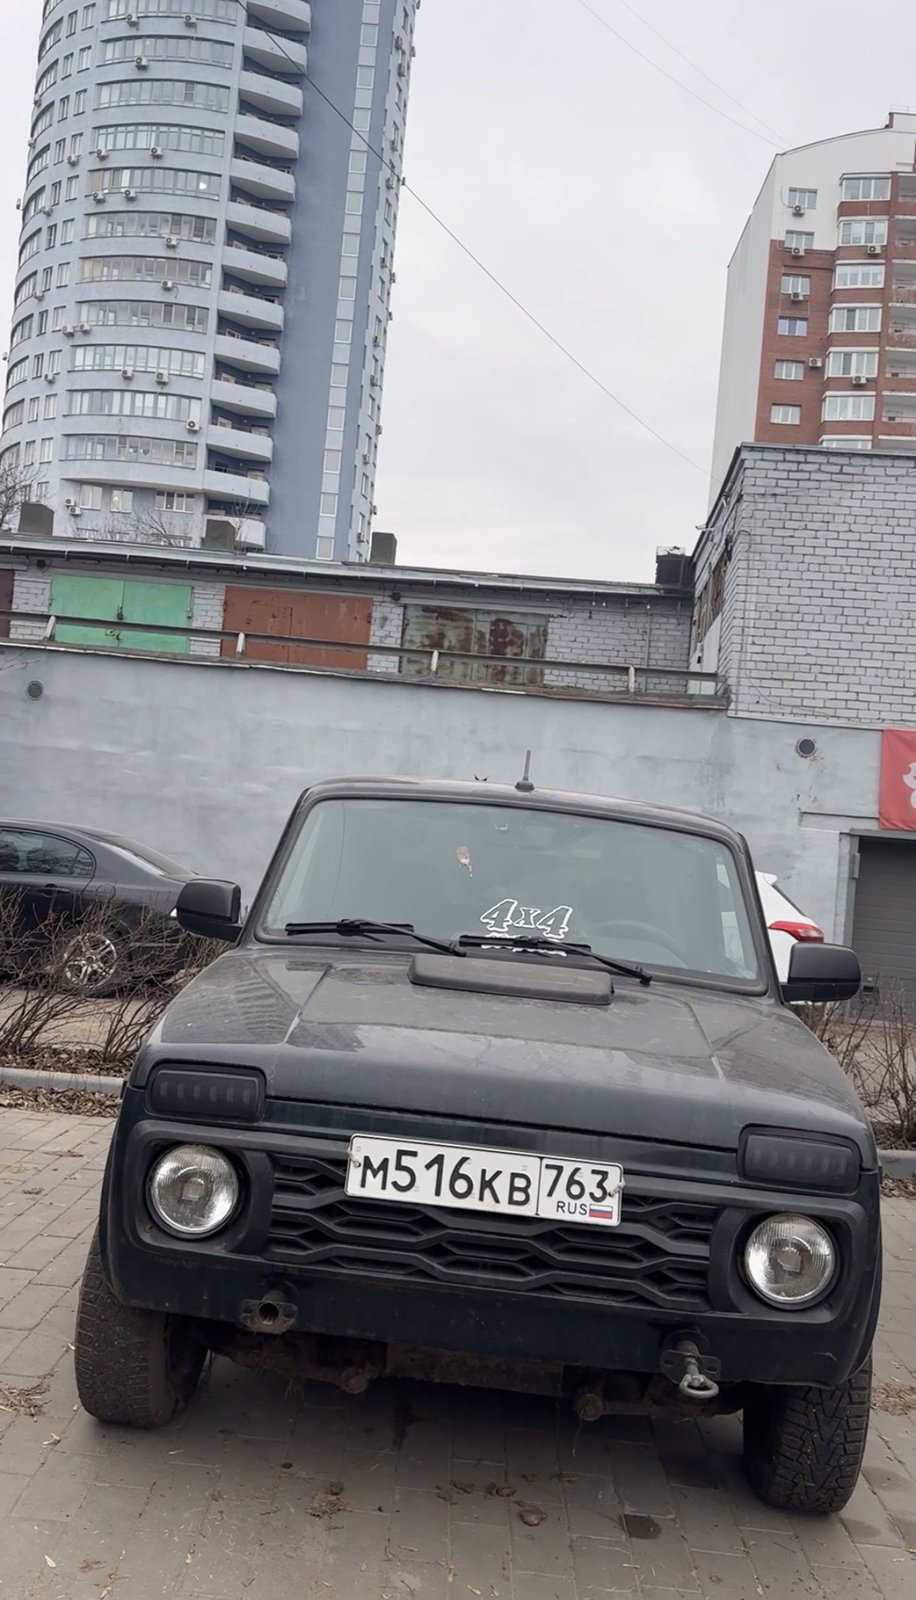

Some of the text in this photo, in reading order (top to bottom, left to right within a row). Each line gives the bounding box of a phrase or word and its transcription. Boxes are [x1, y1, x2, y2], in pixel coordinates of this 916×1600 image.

[360, 1149, 609, 1206] М516КВ 763
[556, 1200, 588, 1216] RUS
